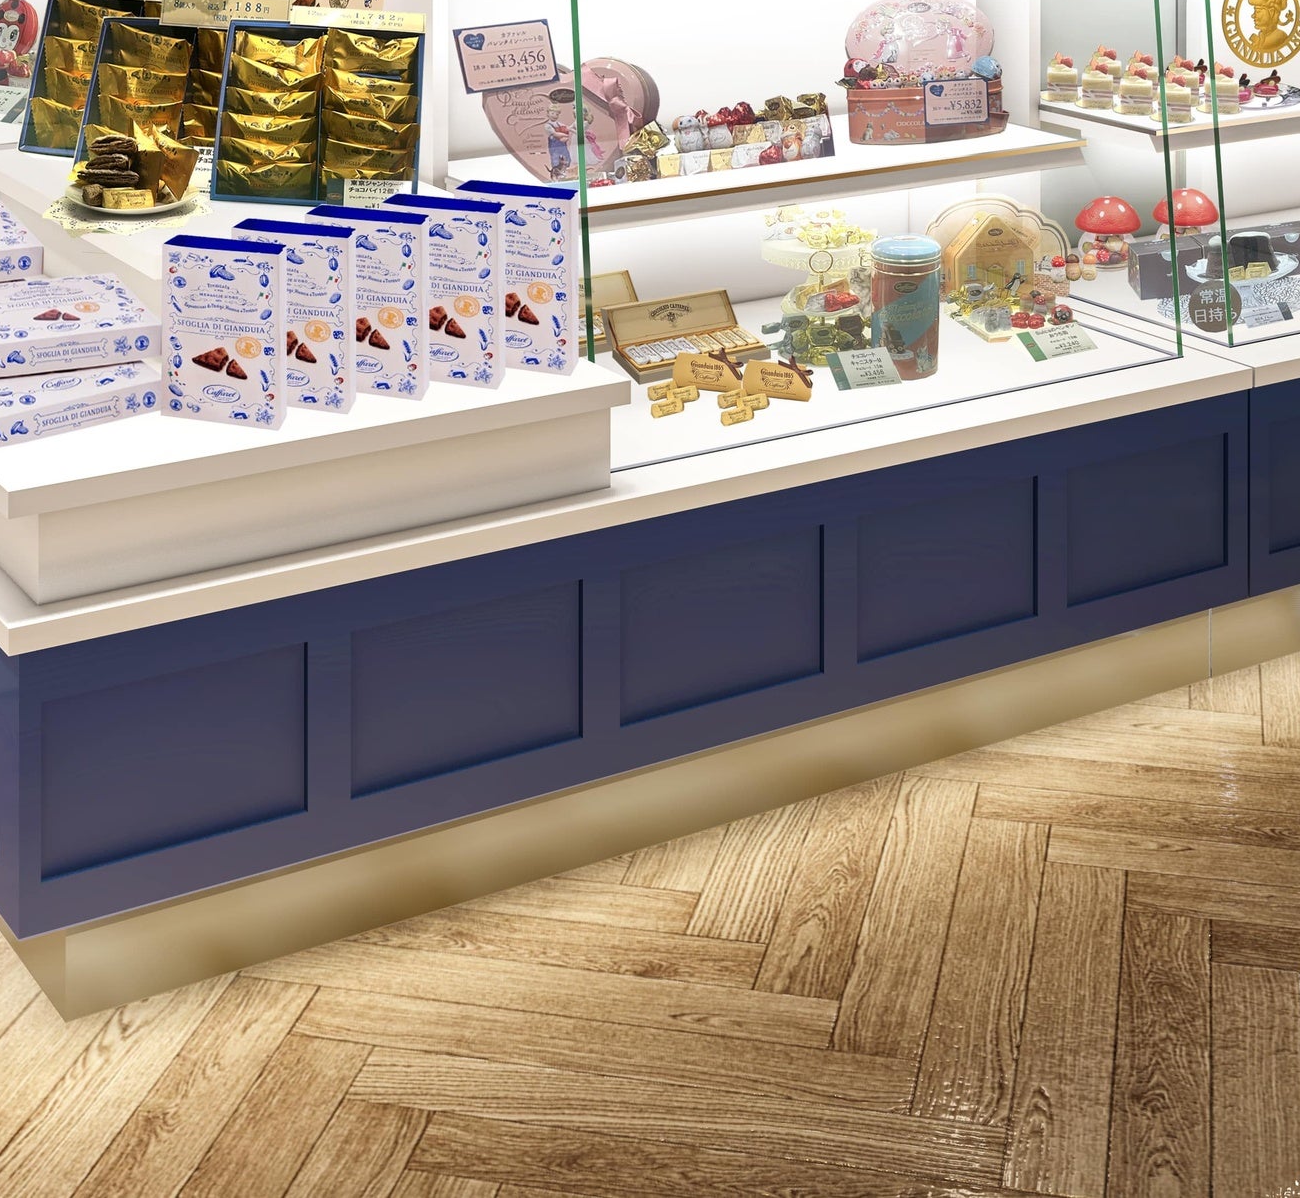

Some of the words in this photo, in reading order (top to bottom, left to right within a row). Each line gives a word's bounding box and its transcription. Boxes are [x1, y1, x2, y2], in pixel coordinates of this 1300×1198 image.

[505, 268, 515, 276] DI
[516, 269, 557, 280] GIANDUIA
[431, 282, 441, 290] DI
[442, 283, 485, 294] GIANDUIA
[356, 293, 364, 301] DI
[366, 294, 408, 304] GIANDUIA
[292, 307, 335, 318] GIANDUIA
[177, 318, 210, 329] SFOGLIA
[224, 324, 265, 334] GIANDUIA
[36, 349, 60, 359] SFOGLIA
[61, 348, 70, 357] DI
[71, 345, 101, 356] GIANDUIA
[205, 387, 237, 402] Caffarel
[41, 414, 70, 427] SFOGLIA
[71, 412, 79, 421] DI
[80, 404, 112, 419] GIANDUIA
